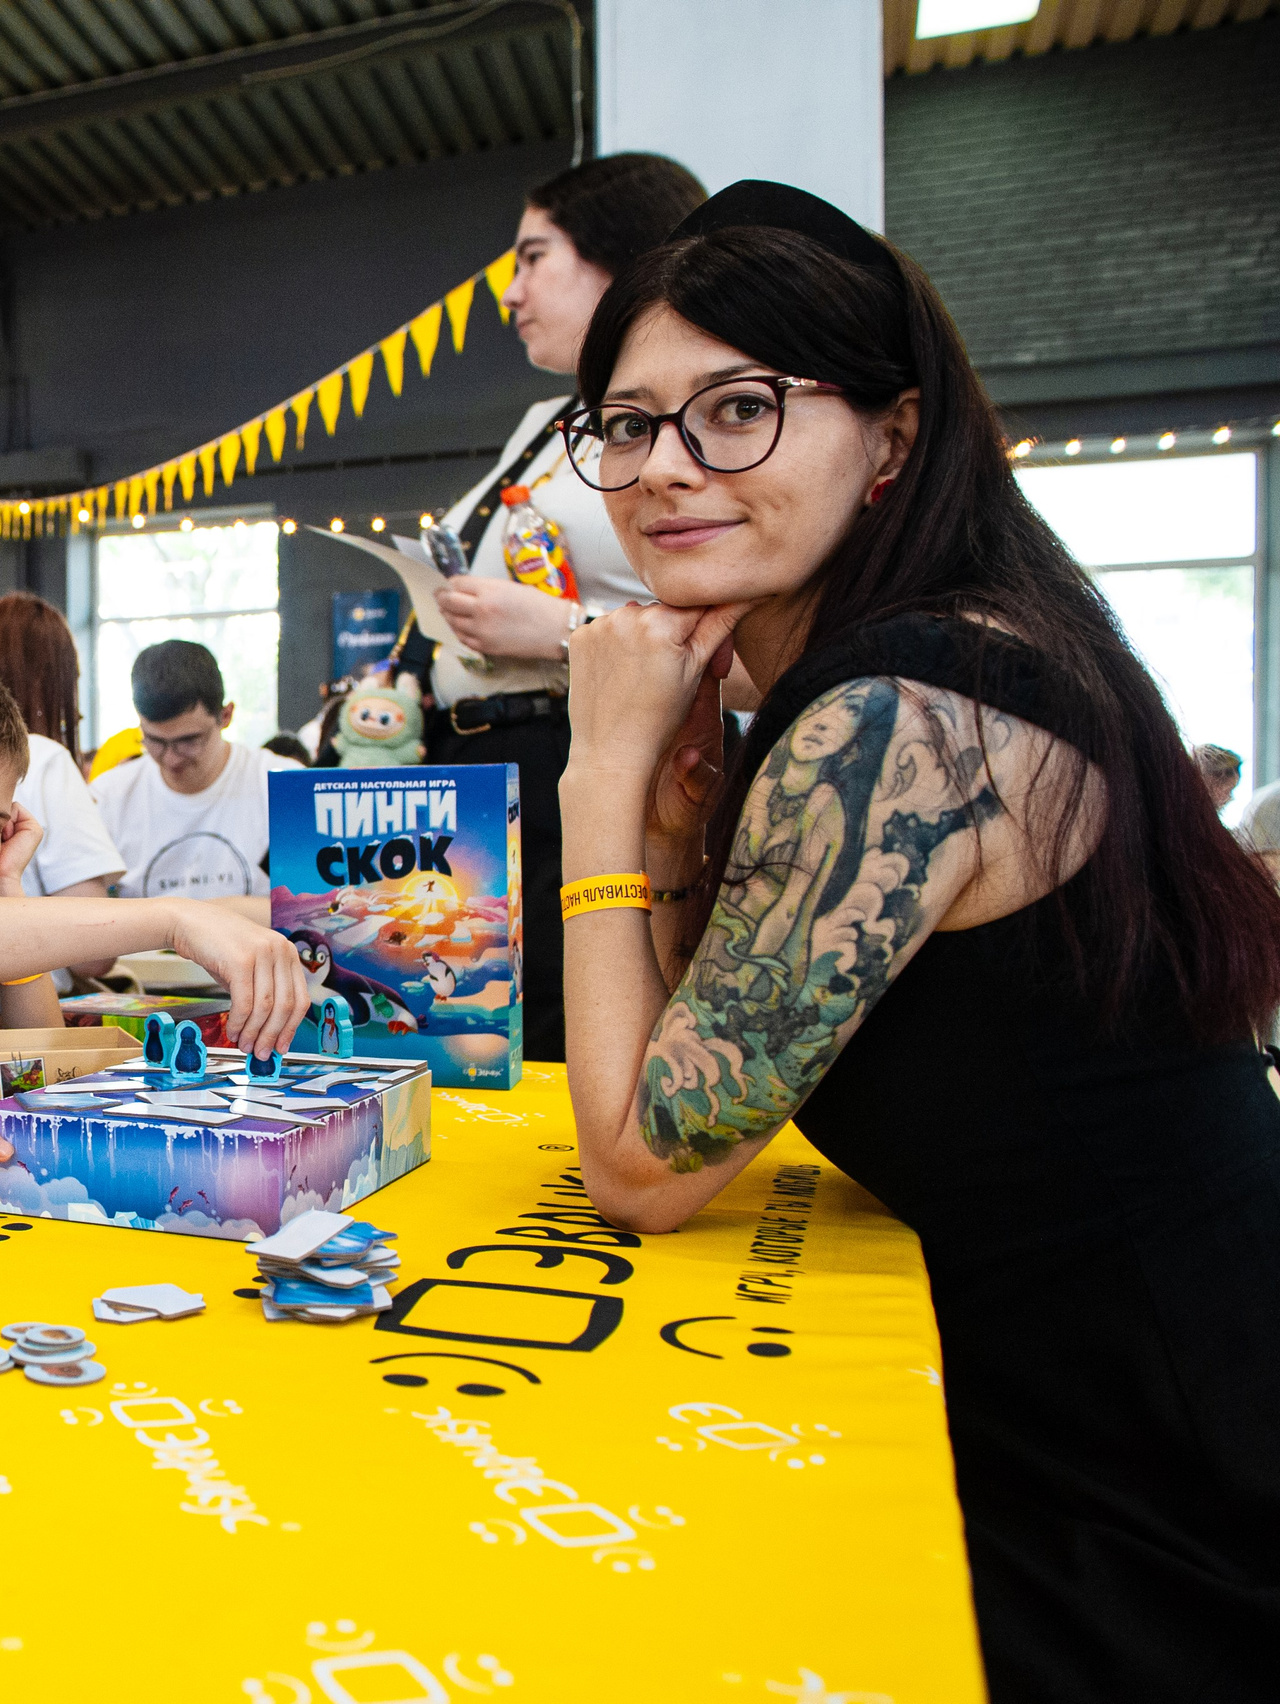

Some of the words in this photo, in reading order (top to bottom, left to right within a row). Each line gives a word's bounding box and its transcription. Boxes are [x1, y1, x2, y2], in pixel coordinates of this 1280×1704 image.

[314, 782, 358, 791] ДЕТСКАЯ
[361, 780, 426, 789] НАСТОЛЬНАЯ
[429, 780, 456, 788] ИГРА
[314, 789, 457, 838] ПИНГИ
[316, 833, 454, 887] СКОК
[582, 884, 648, 902] ФЕСТИВАЛЬ
[763, 1199, 813, 1214] ТЫ
[746, 1216, 809, 1265] КОТОРЫЕ
